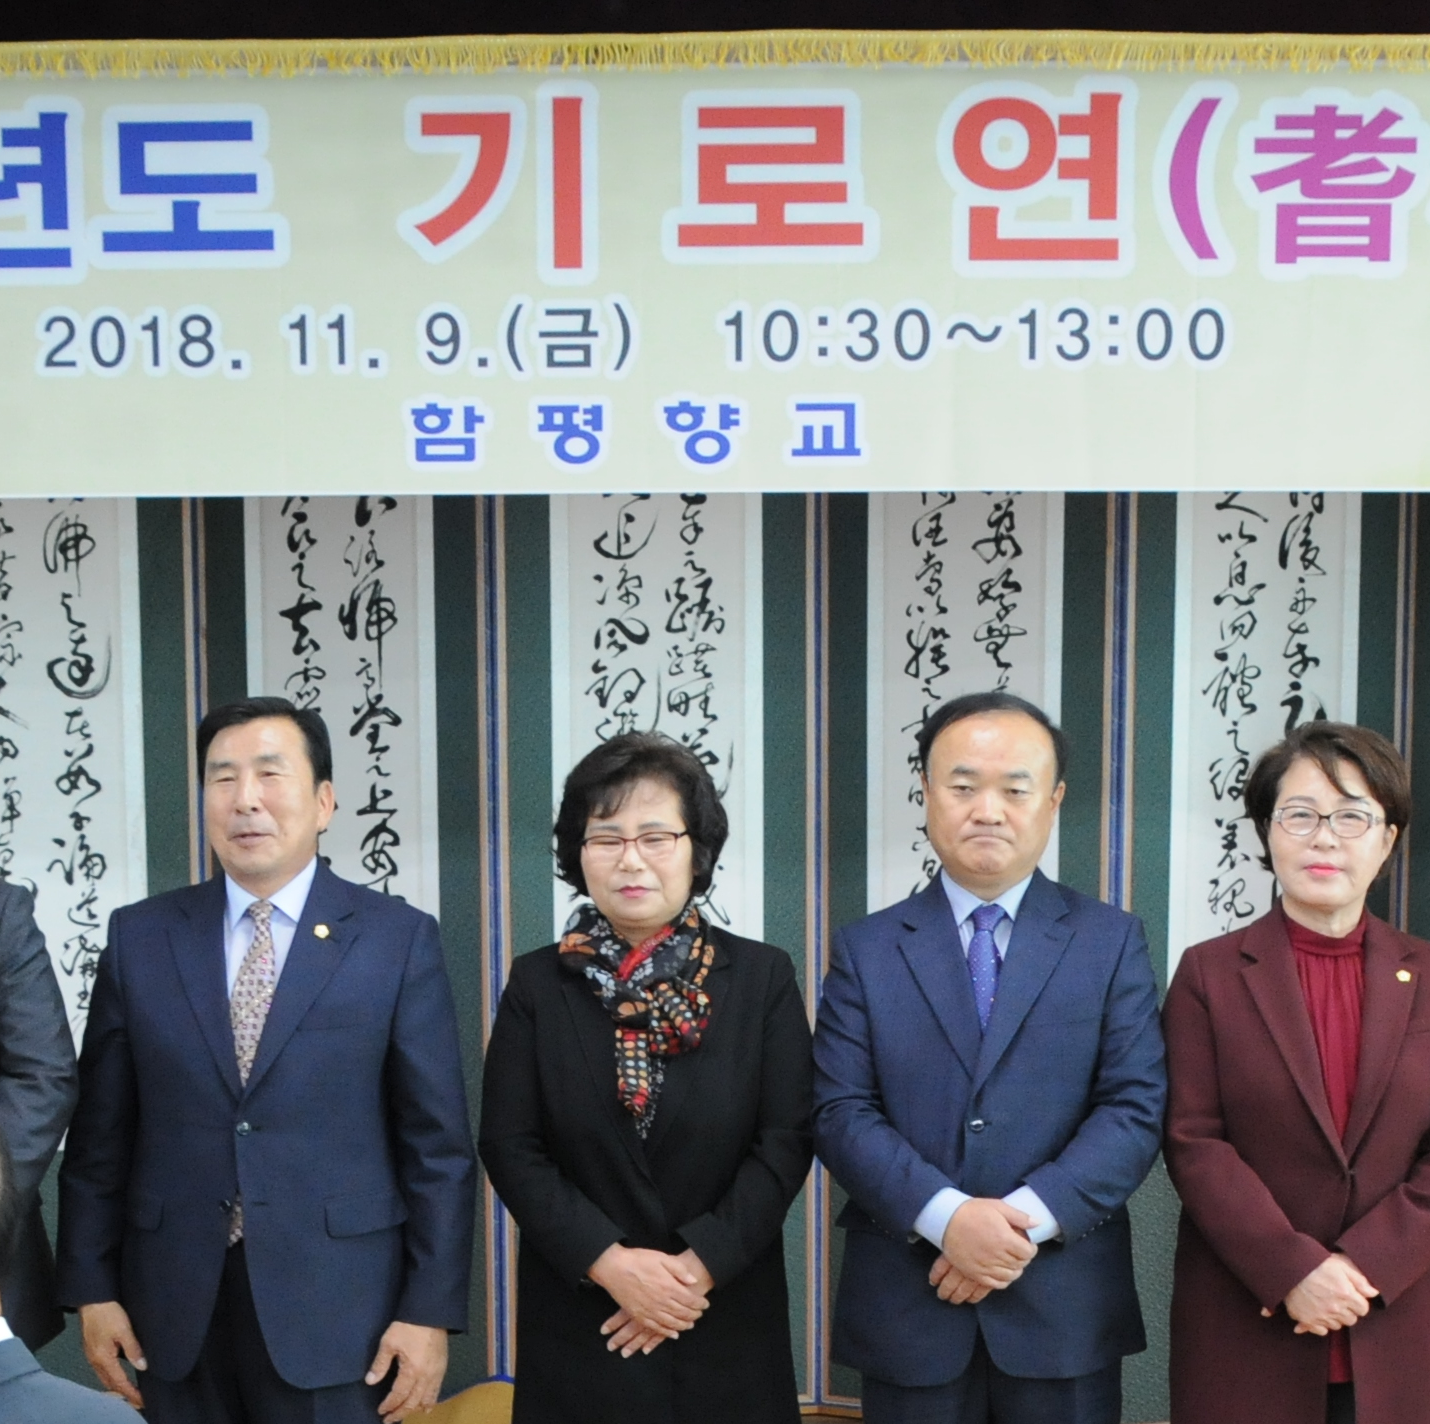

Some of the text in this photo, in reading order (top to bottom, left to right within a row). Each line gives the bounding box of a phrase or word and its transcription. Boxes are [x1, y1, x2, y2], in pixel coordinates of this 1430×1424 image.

[43, 301, 1226, 373] 2018. 11. 9.(금) 10:30~13:00
